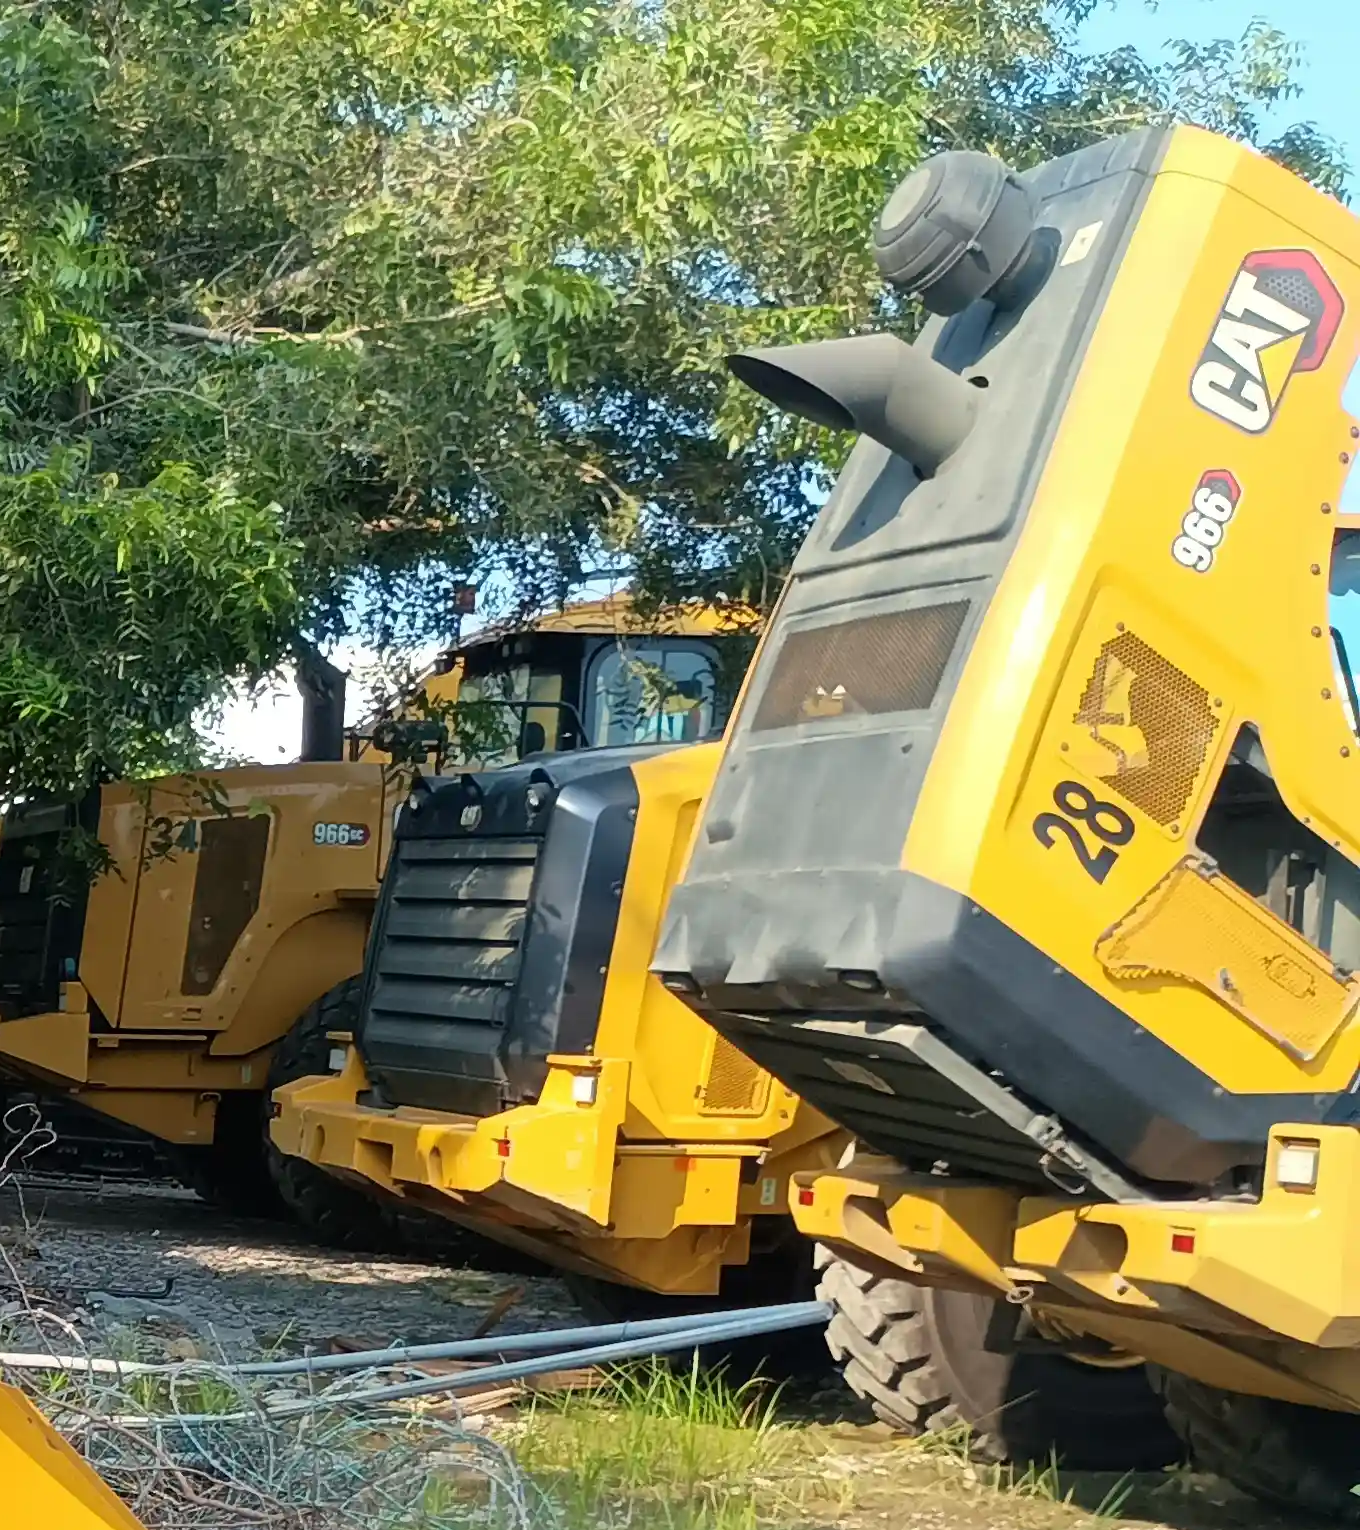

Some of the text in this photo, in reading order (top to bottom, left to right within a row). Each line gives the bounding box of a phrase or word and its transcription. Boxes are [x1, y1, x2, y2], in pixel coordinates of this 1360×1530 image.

[1191, 270, 1311, 431] CAT
[1173, 487, 1233, 571] 966
[314, 823, 350, 844] 966
[1032, 780, 1135, 886] 28
